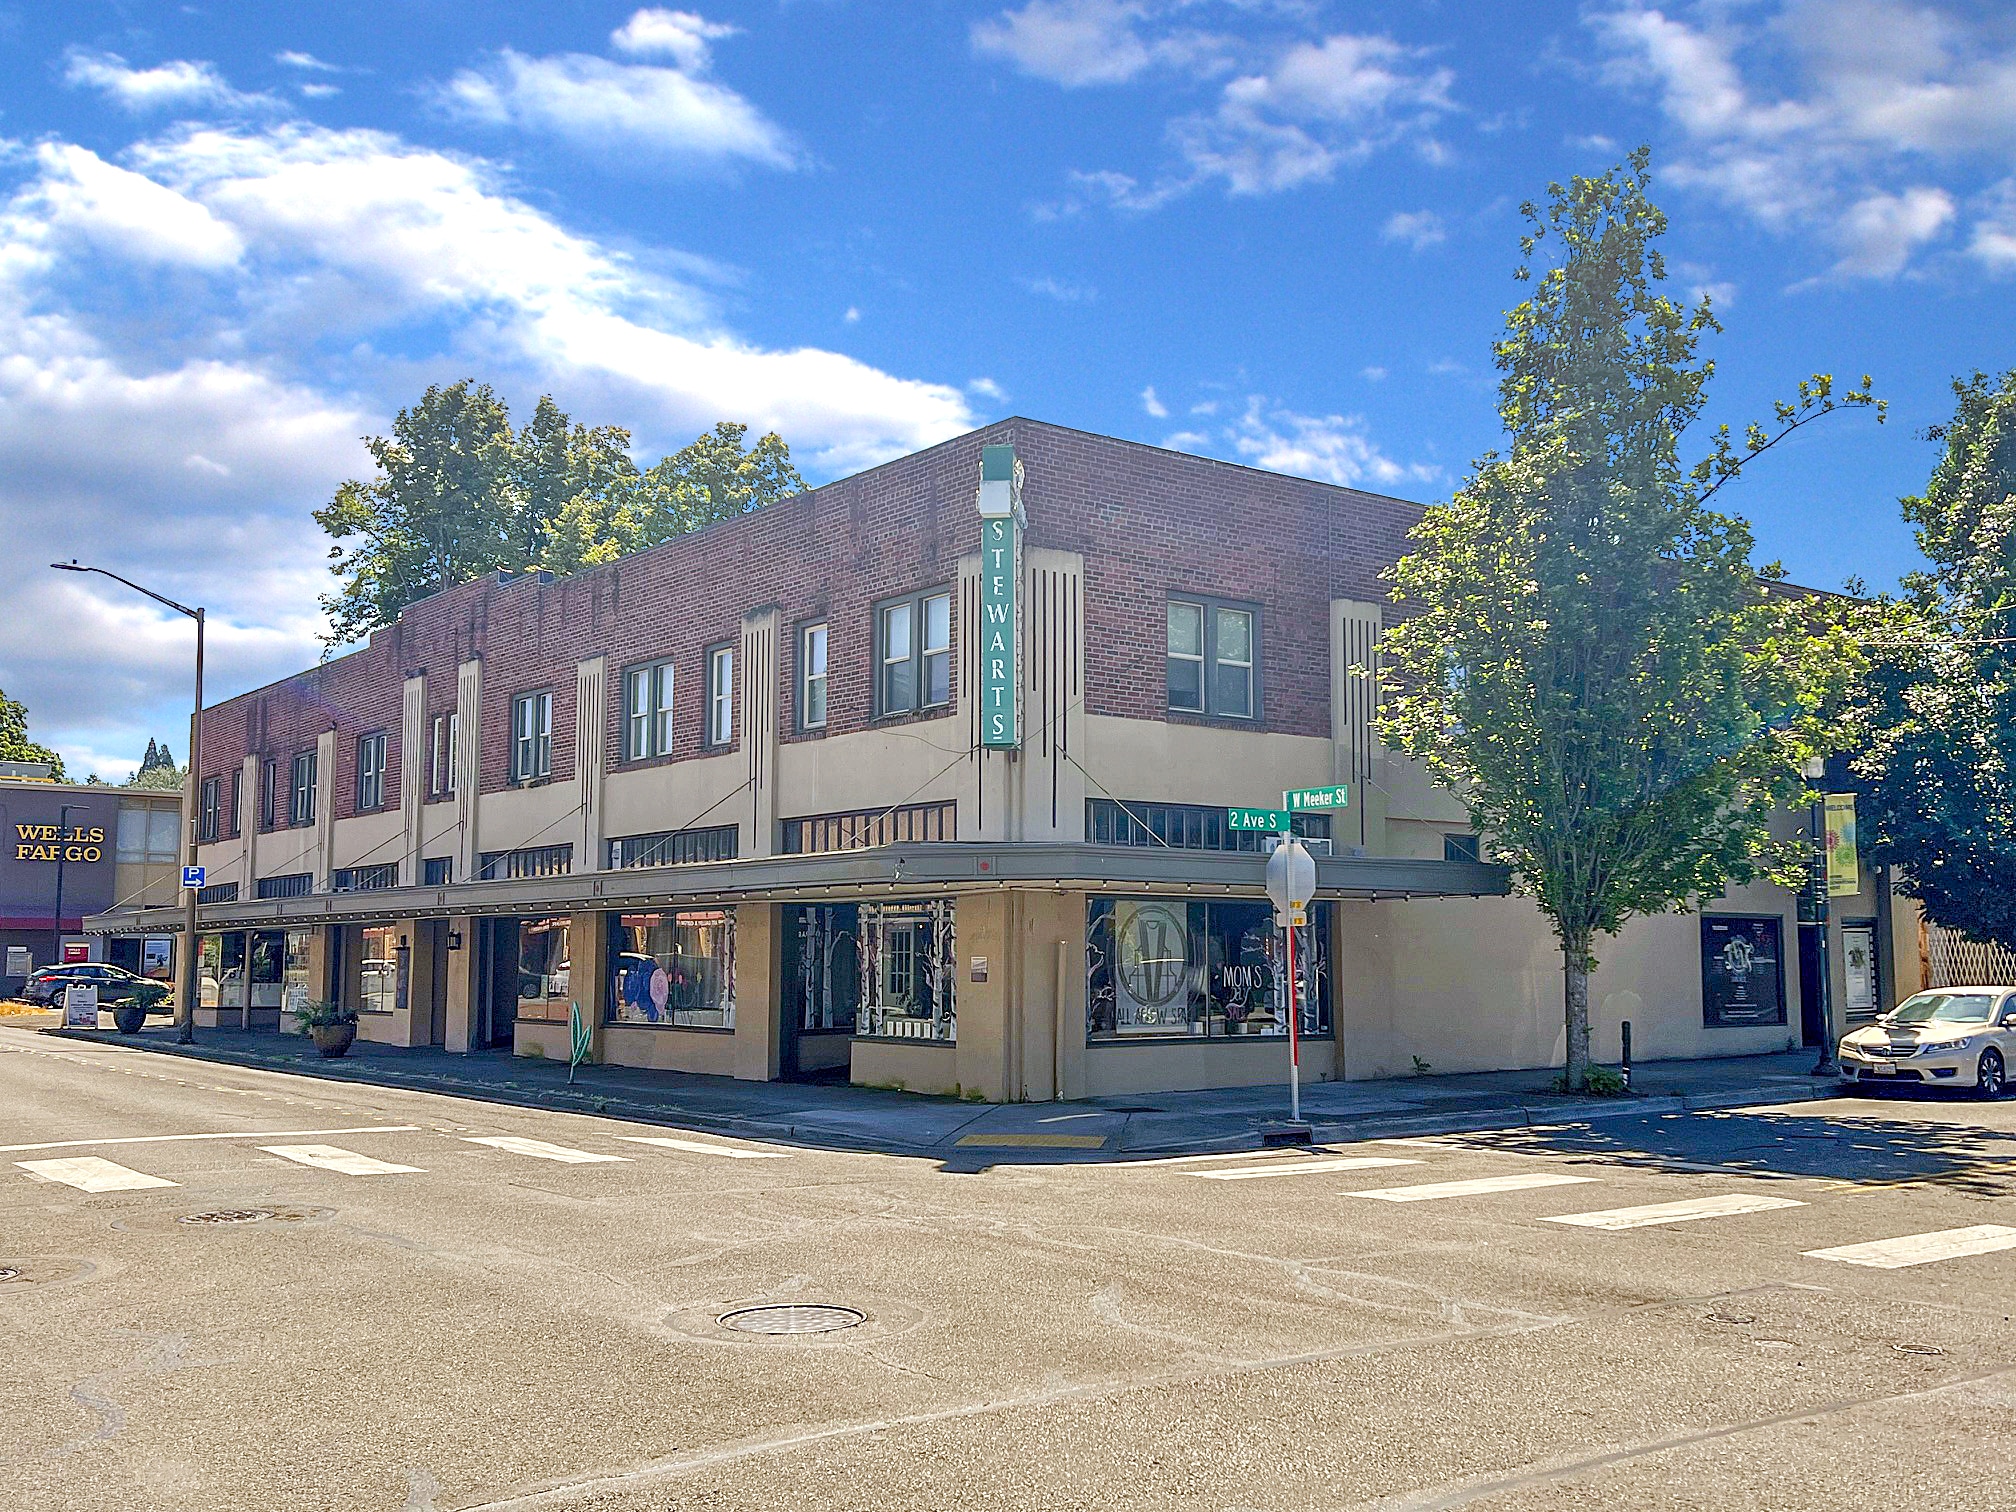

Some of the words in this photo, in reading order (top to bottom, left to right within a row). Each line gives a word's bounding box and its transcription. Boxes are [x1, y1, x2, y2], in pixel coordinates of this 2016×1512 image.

[986, 521, 1010, 736] STEWARTS
[1293, 792, 1301, 808] W
[1303, 791, 1333, 807] Meeker
[1336, 788, 1346, 804] St
[1230, 811, 1239, 827] 2
[1243, 812, 1265, 828] Ave
[1269, 813, 1277, 828] S
[15, 844, 102, 862] FARGO
[188, 868, 200, 879] P
